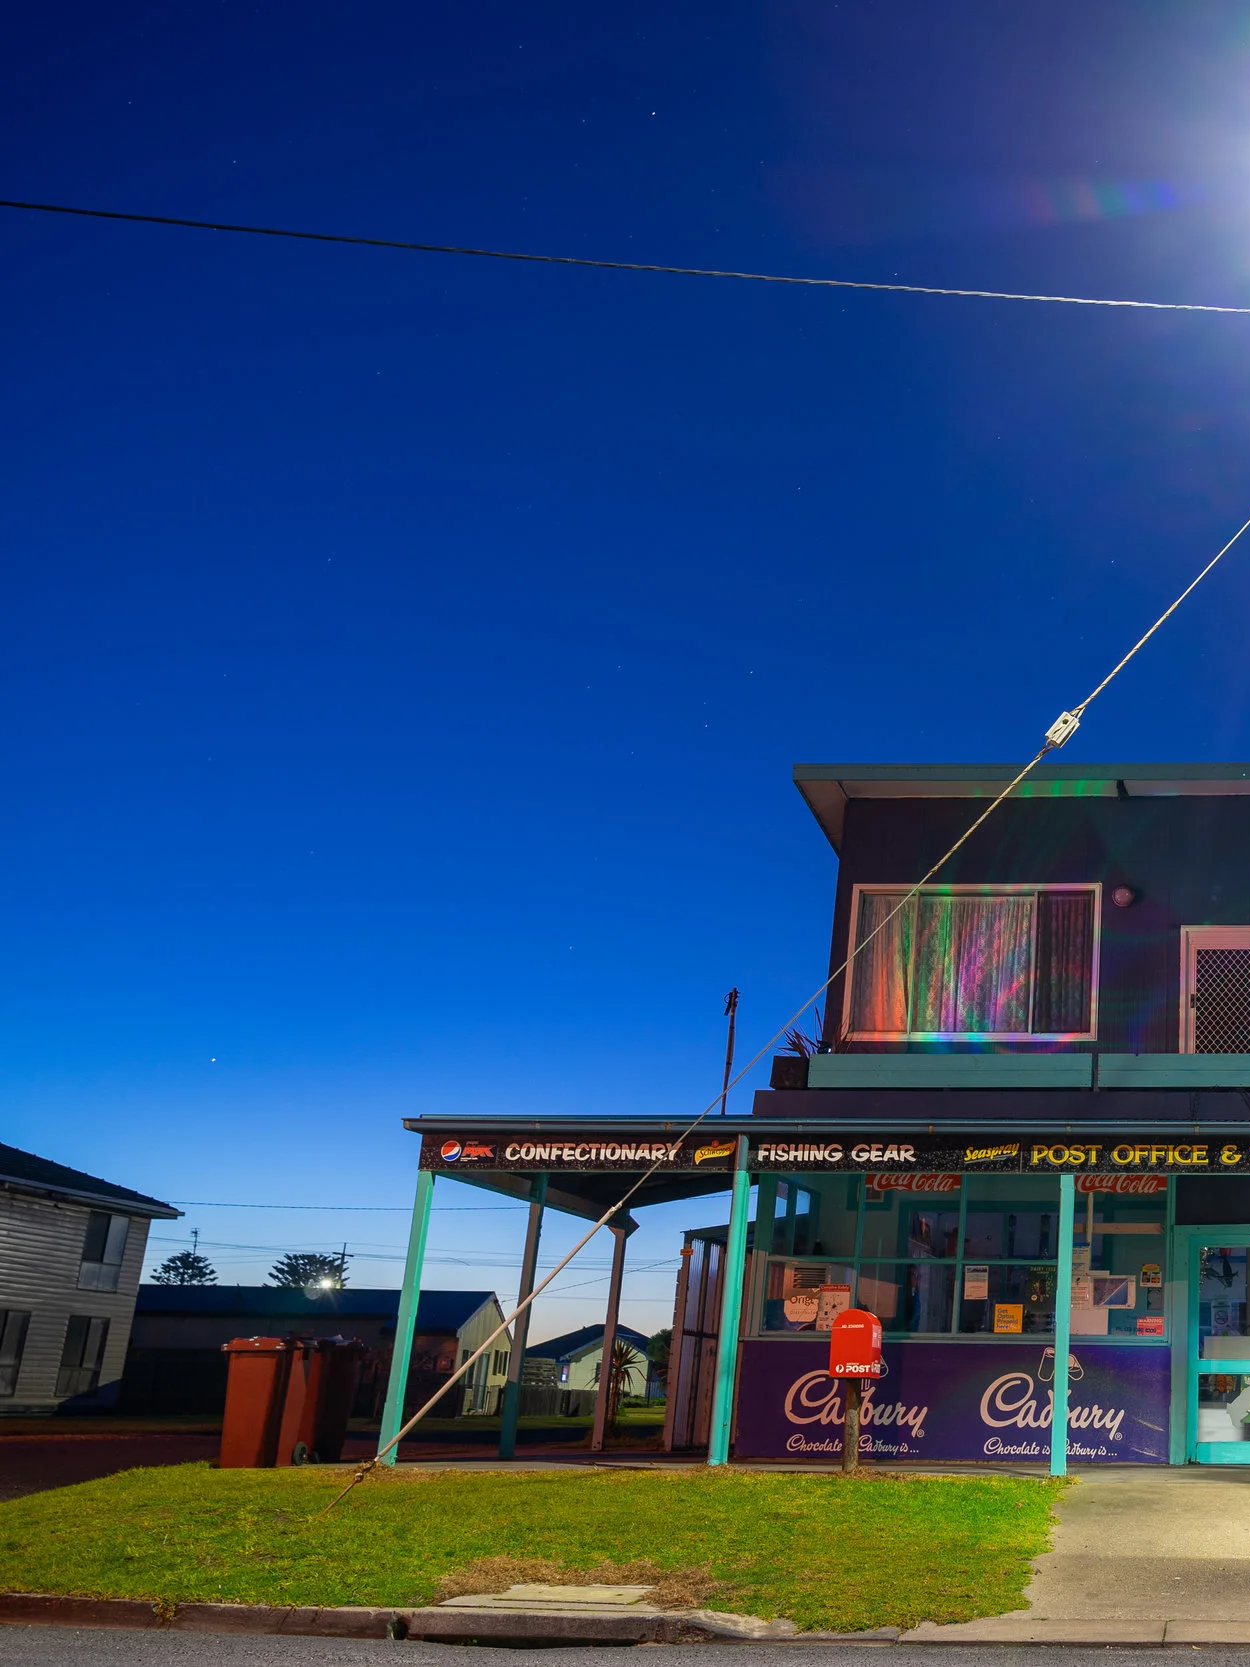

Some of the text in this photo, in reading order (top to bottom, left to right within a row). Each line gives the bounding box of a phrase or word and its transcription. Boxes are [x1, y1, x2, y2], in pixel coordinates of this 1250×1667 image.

[504, 1141, 682, 1162] CONFECTIONARY
[757, 1142, 917, 1162] FISHING GEAR
[963, 1142, 1020, 1161] Seaspray
[1031, 1144, 1102, 1165] POST
[1112, 1144, 1209, 1165] OFFICE
[1221, 1145, 1242, 1164] &
[845, 1365, 871, 1374] POST
[785, 1370, 928, 1438] Cabury
[980, 1372, 1125, 1441] Cadury
[786, 1434, 843, 1452] Chocolate
[983, 1436, 1040, 1455] Chocolate
